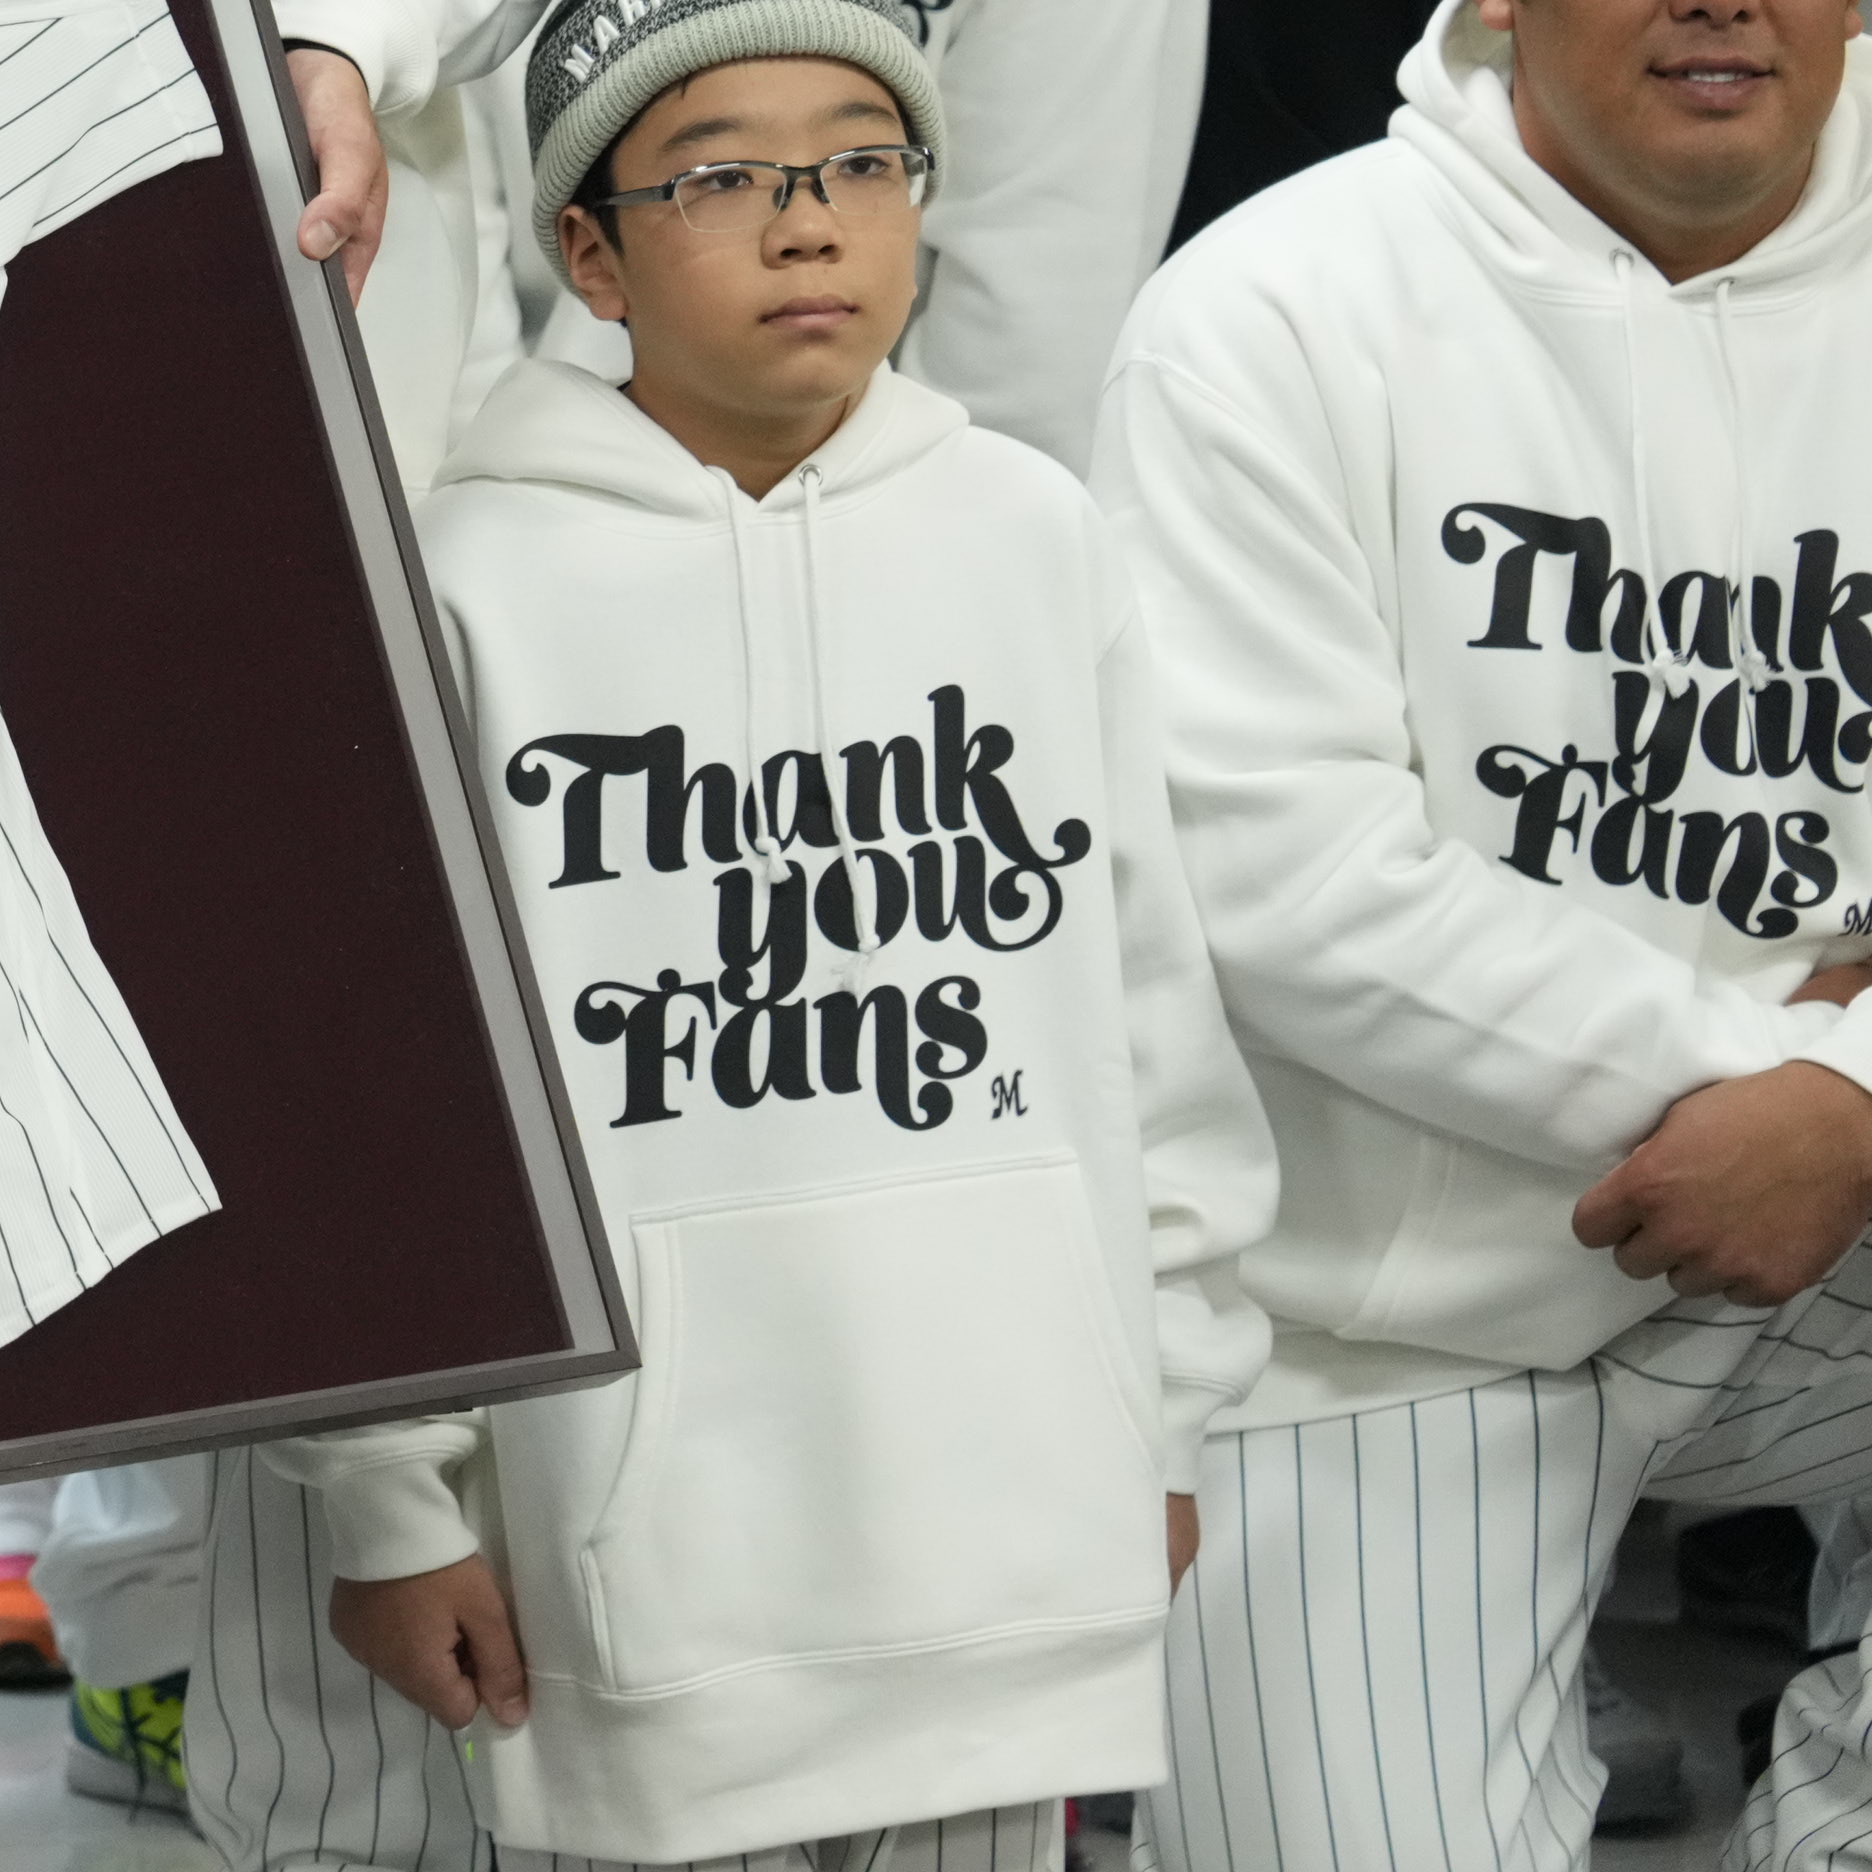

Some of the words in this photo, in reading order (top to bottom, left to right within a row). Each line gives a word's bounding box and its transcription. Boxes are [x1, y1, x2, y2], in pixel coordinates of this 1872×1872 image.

[506, 684, 1092, 889] Thank
[1475, 743, 1838, 939] Fans
[712, 834, 1064, 1008] you
[574, 968, 988, 1132] Fans
[990, 1069, 1029, 1121] M
